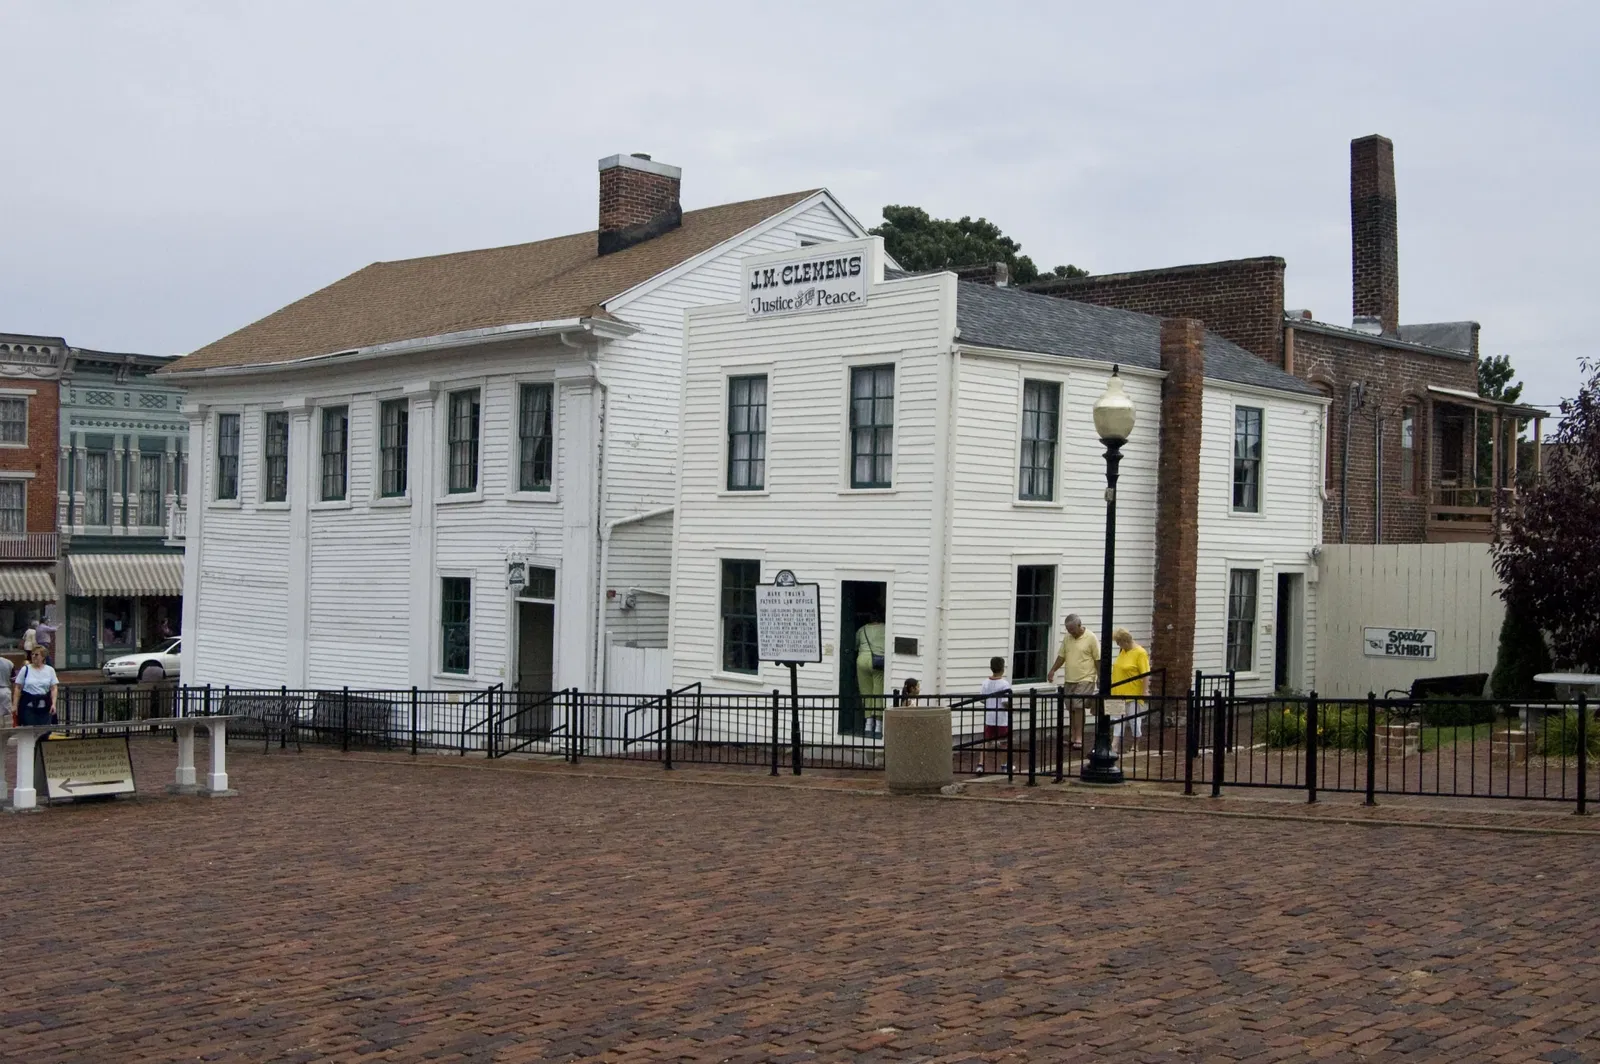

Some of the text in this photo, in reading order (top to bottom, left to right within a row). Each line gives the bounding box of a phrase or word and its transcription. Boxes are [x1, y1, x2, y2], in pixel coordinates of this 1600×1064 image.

[751, 256, 862, 289] J.M. CLEMENS
[751, 295, 794, 314] Justice
[816, 289, 861, 306] Peace.
[1385, 629, 1433, 657] Special EXHIBIT
